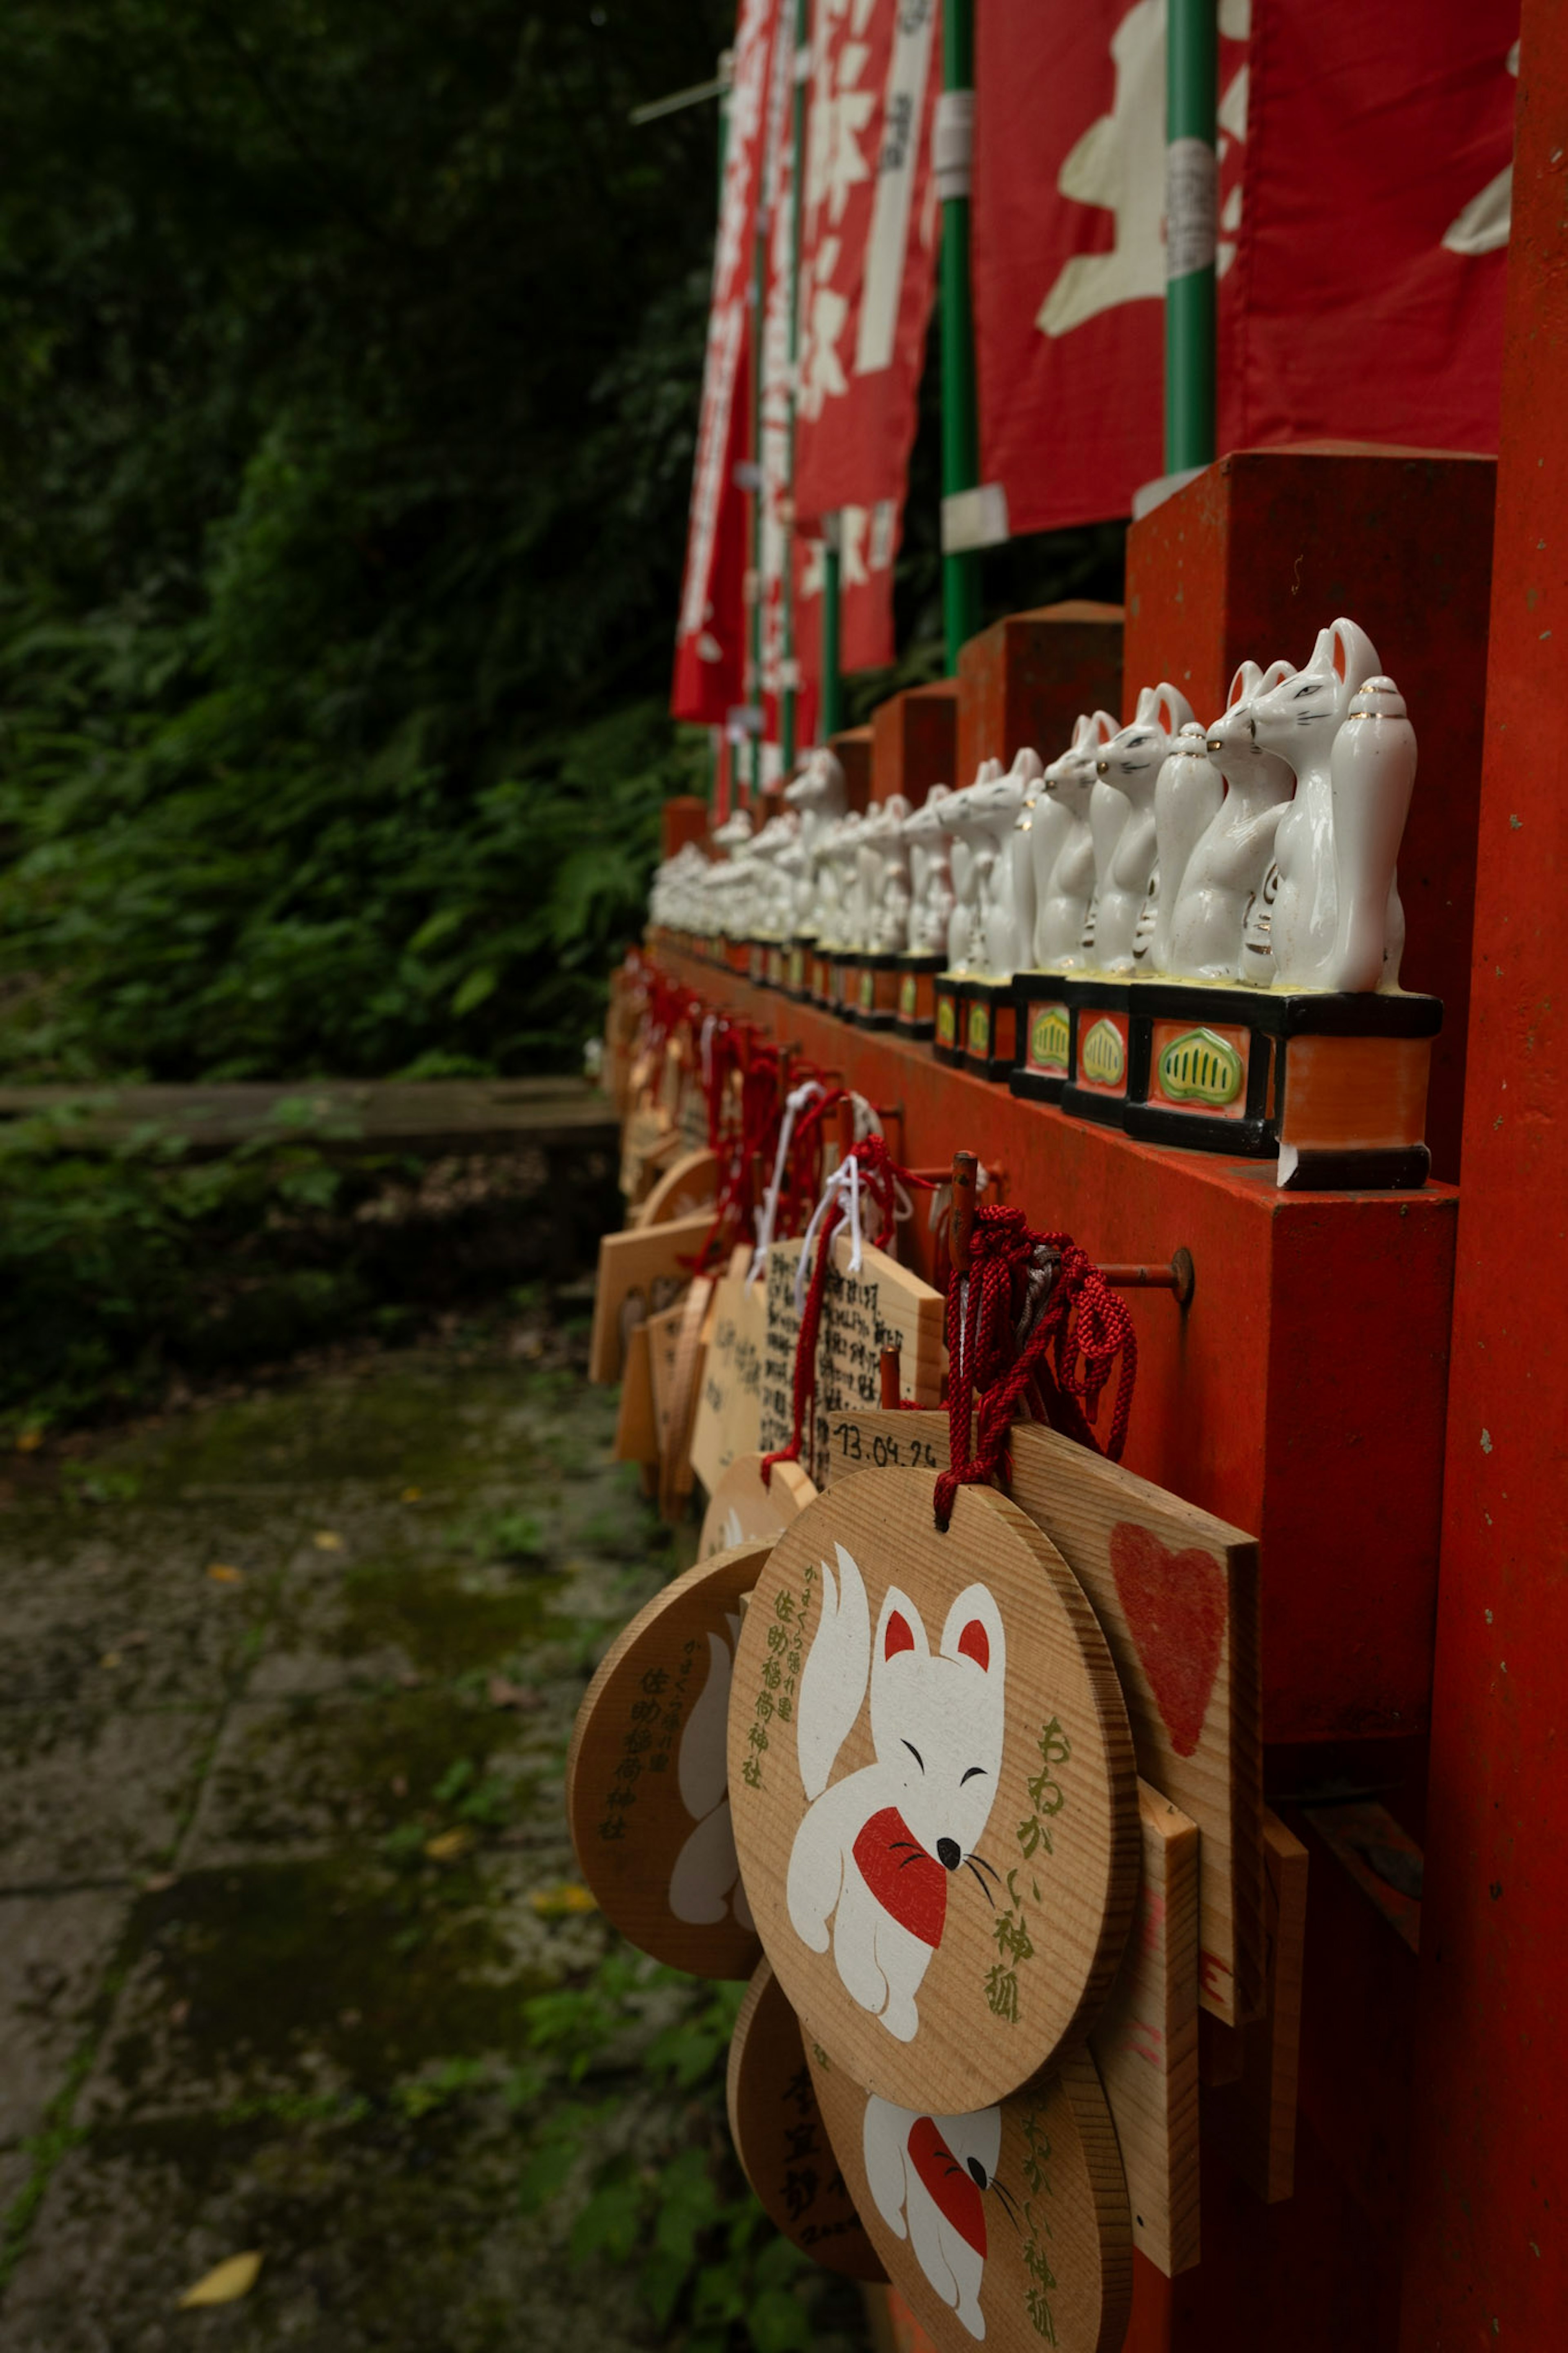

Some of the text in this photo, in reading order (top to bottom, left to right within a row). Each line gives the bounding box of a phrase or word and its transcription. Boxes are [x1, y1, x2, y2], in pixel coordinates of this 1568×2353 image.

[742, 1590, 796, 1789] 佐助稲荷神社
[983, 1716, 1072, 2024] おねがい神狐
